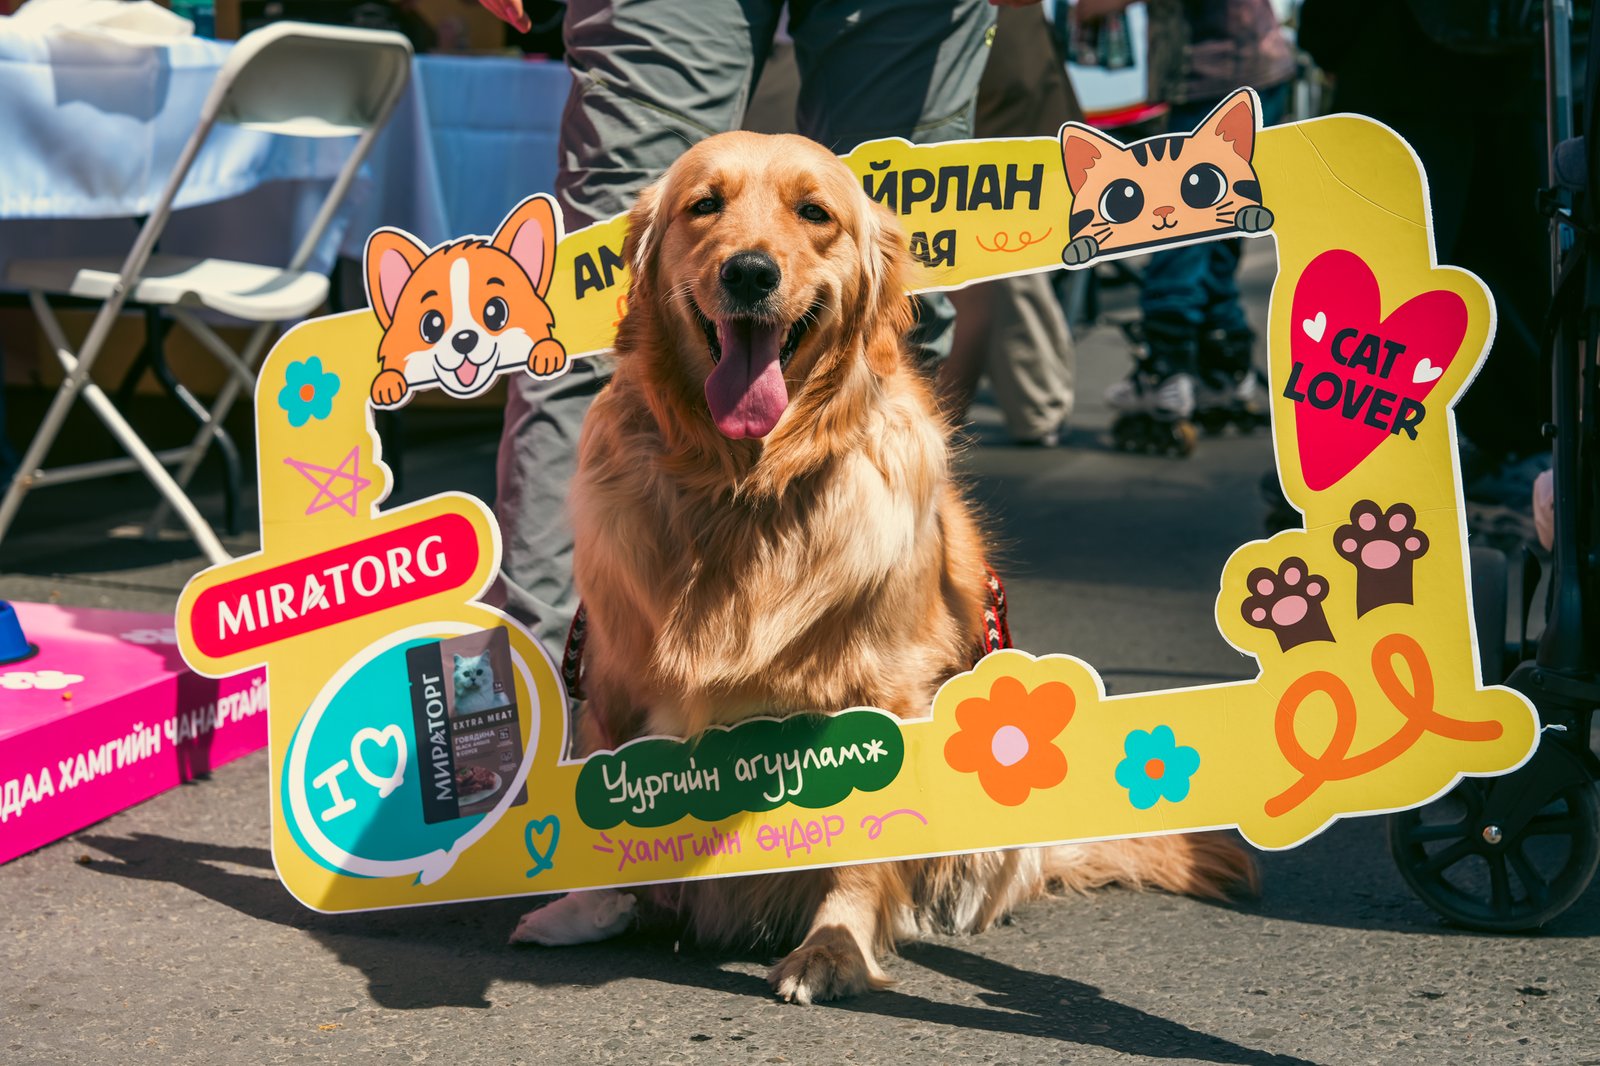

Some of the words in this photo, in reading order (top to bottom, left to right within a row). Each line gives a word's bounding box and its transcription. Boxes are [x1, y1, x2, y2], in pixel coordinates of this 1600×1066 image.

[1330, 327, 1407, 380] CAT
[1282, 361, 1427, 441] LOVER
[217, 535, 448, 640] MIRATORG
[422, 673, 453, 801] МИРАТОРГ
[453, 717, 484, 730] EXTRA
[487, 710, 513, 722] MEAT
[0, 766, 55, 823] ДАА
[58, 722, 161, 793] ХАМГИЙН
[601, 757, 720, 814] Уургийн
[734, 738, 889, 802] агууламж
